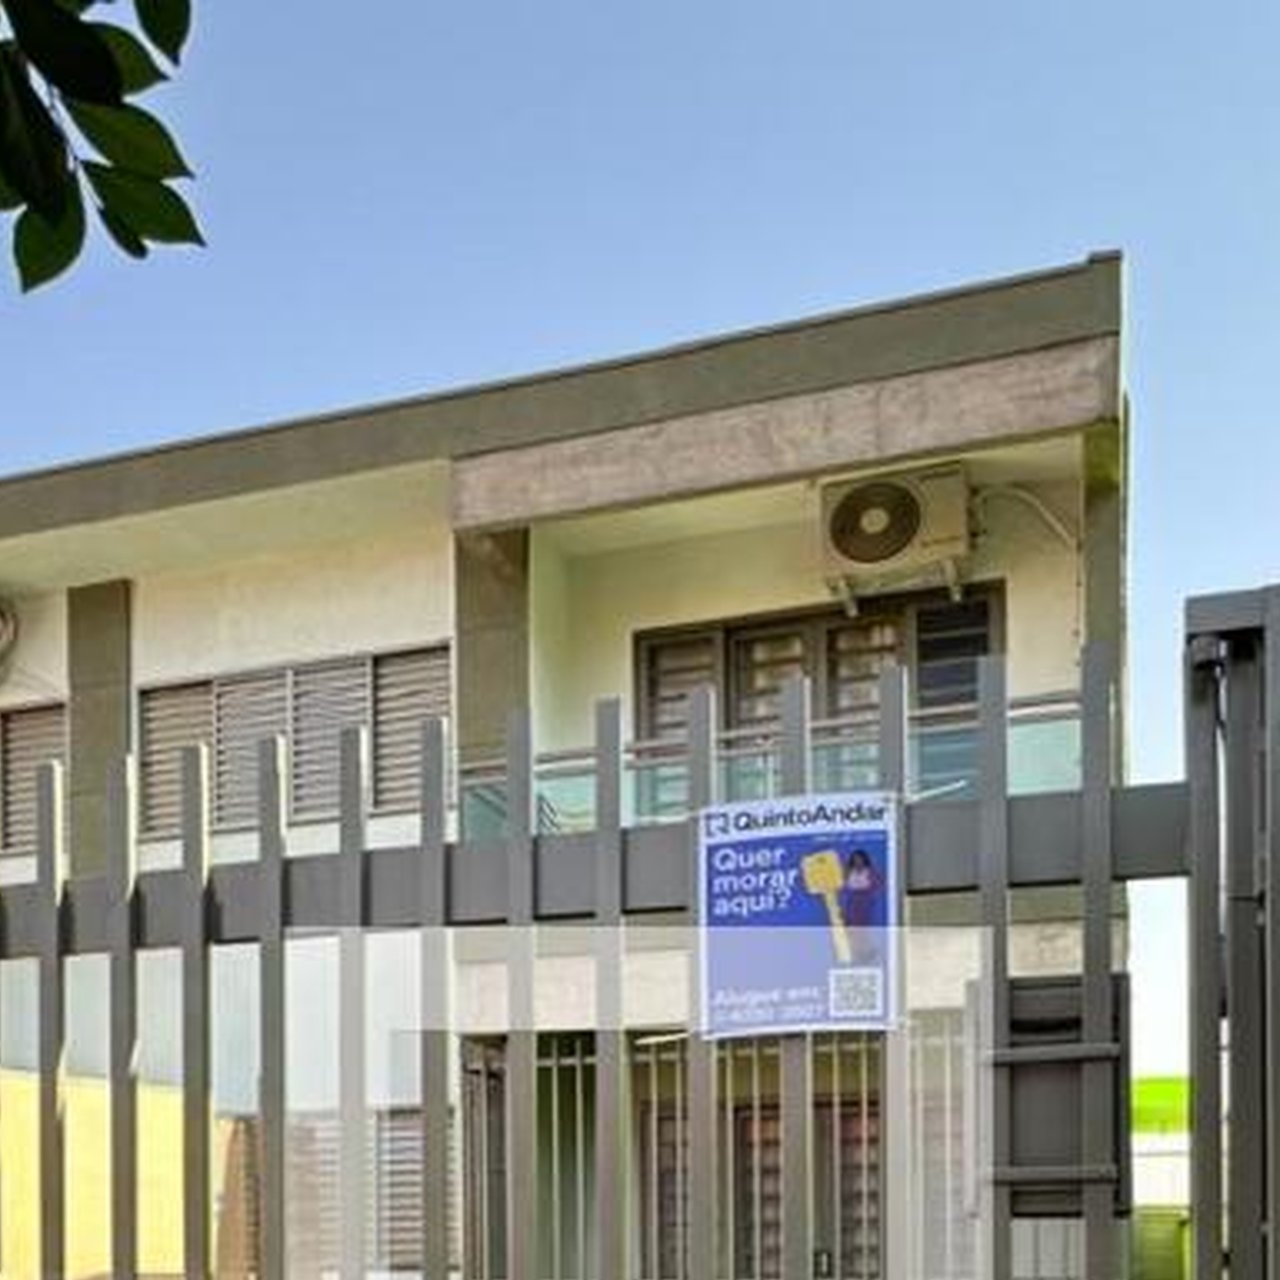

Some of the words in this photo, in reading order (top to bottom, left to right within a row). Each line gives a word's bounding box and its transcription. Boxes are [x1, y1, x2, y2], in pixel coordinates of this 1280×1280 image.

[733, 804, 885, 832] QuintoAndar
[713, 847, 787, 872] Quer
[712, 869, 799, 894] morar
[713, 889, 792, 917] aqui?
